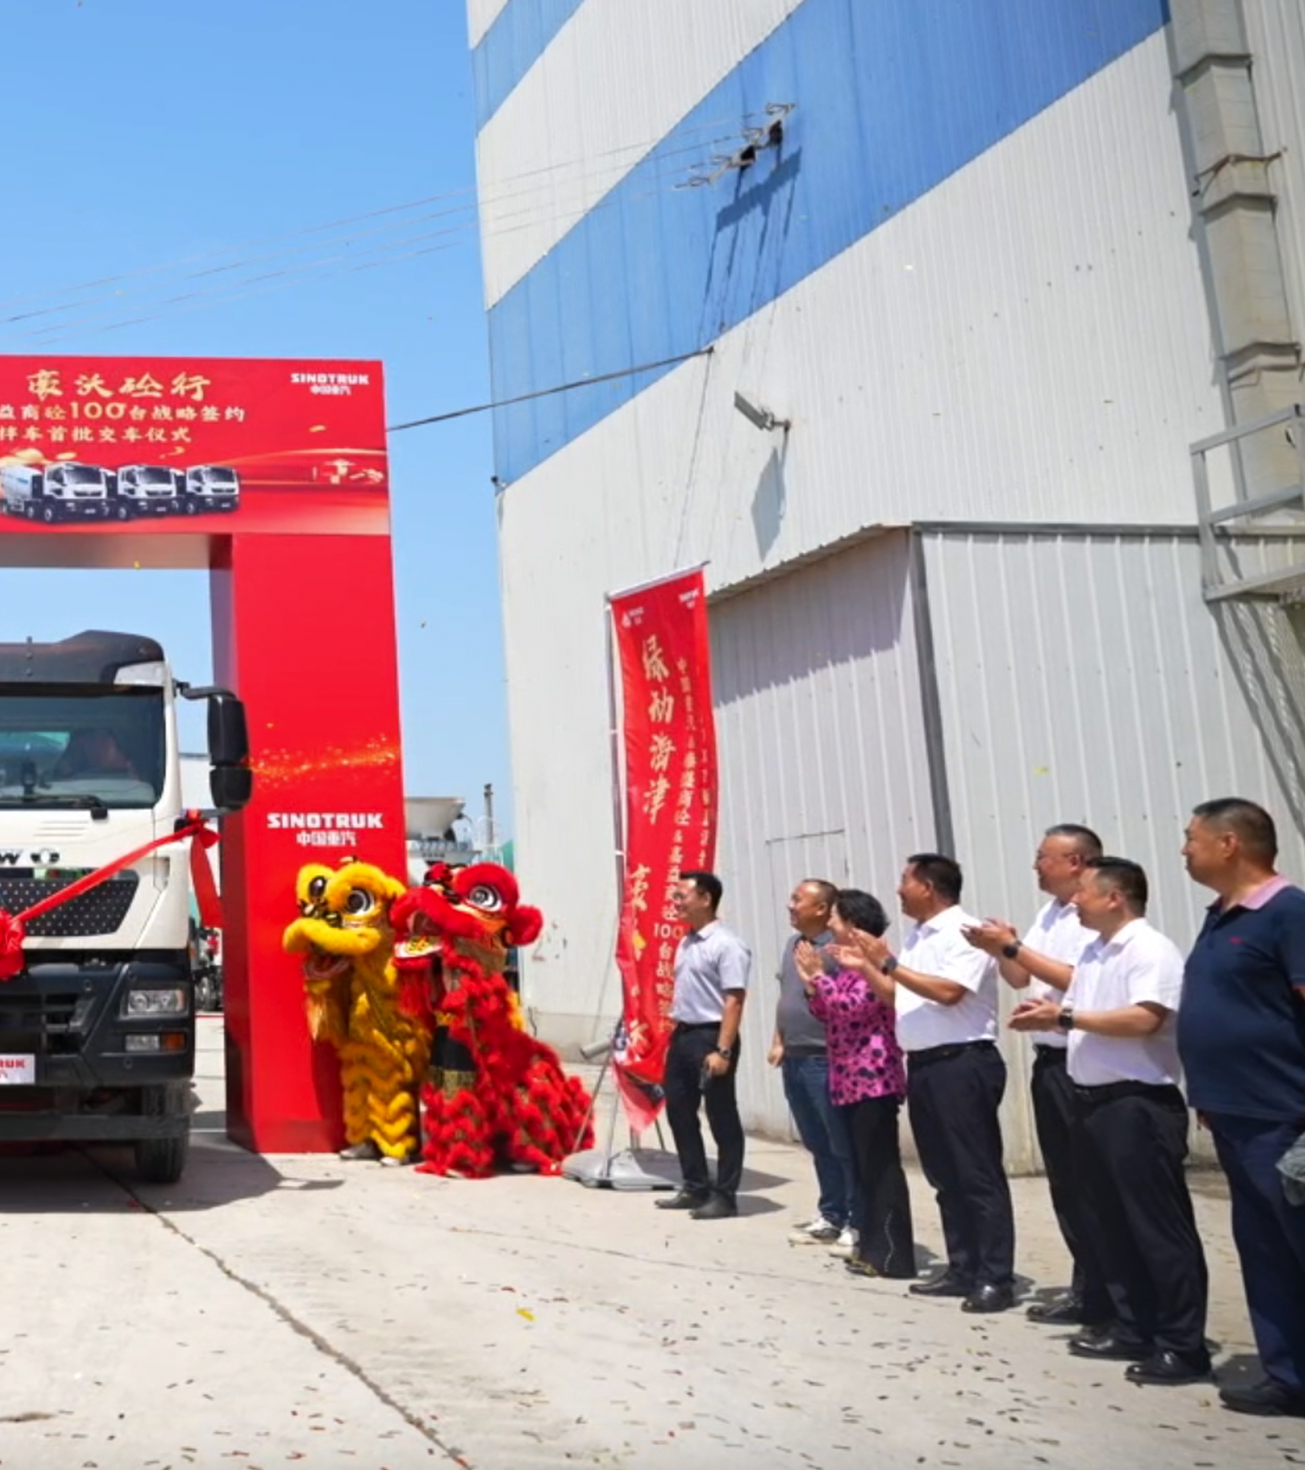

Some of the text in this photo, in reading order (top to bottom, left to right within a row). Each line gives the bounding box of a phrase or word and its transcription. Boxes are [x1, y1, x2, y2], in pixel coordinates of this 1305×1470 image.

[26, 368, 212, 401] 豪沃砼行
[290, 372, 370, 385] SINOTRUK
[267, 812, 384, 829] SINOTRUK
[296, 830, 357, 847] 中国重汽
